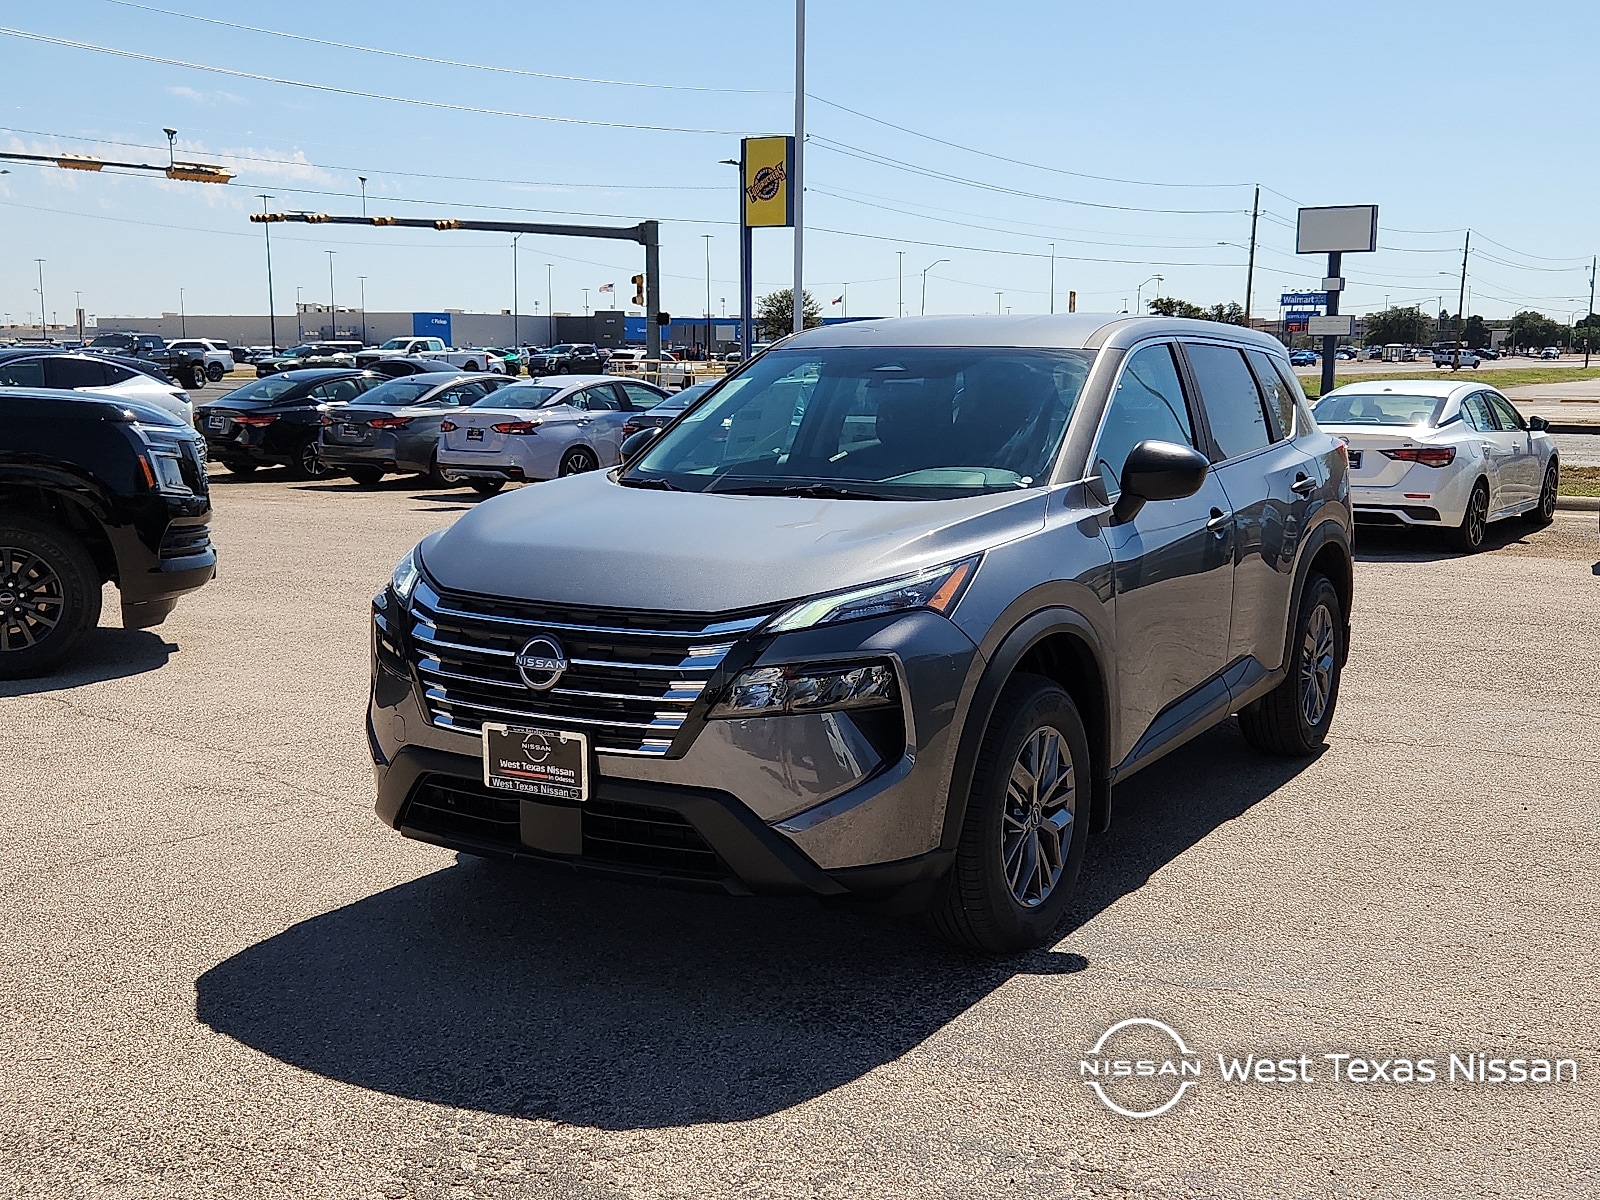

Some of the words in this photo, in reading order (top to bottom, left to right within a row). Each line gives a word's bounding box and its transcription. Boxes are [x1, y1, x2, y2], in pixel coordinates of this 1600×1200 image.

[1283, 295, 1315, 304] Walmart
[515, 655, 568, 670] NISSAN
[521, 742, 551, 752] NISSAN
[499, 759, 521, 769] West
[521, 762, 546, 773] Texas
[546, 765, 575, 777] Nissan
[491, 777, 513, 788] West
[515, 780, 539, 792] Texas
[540, 784, 569, 797] Nissan
